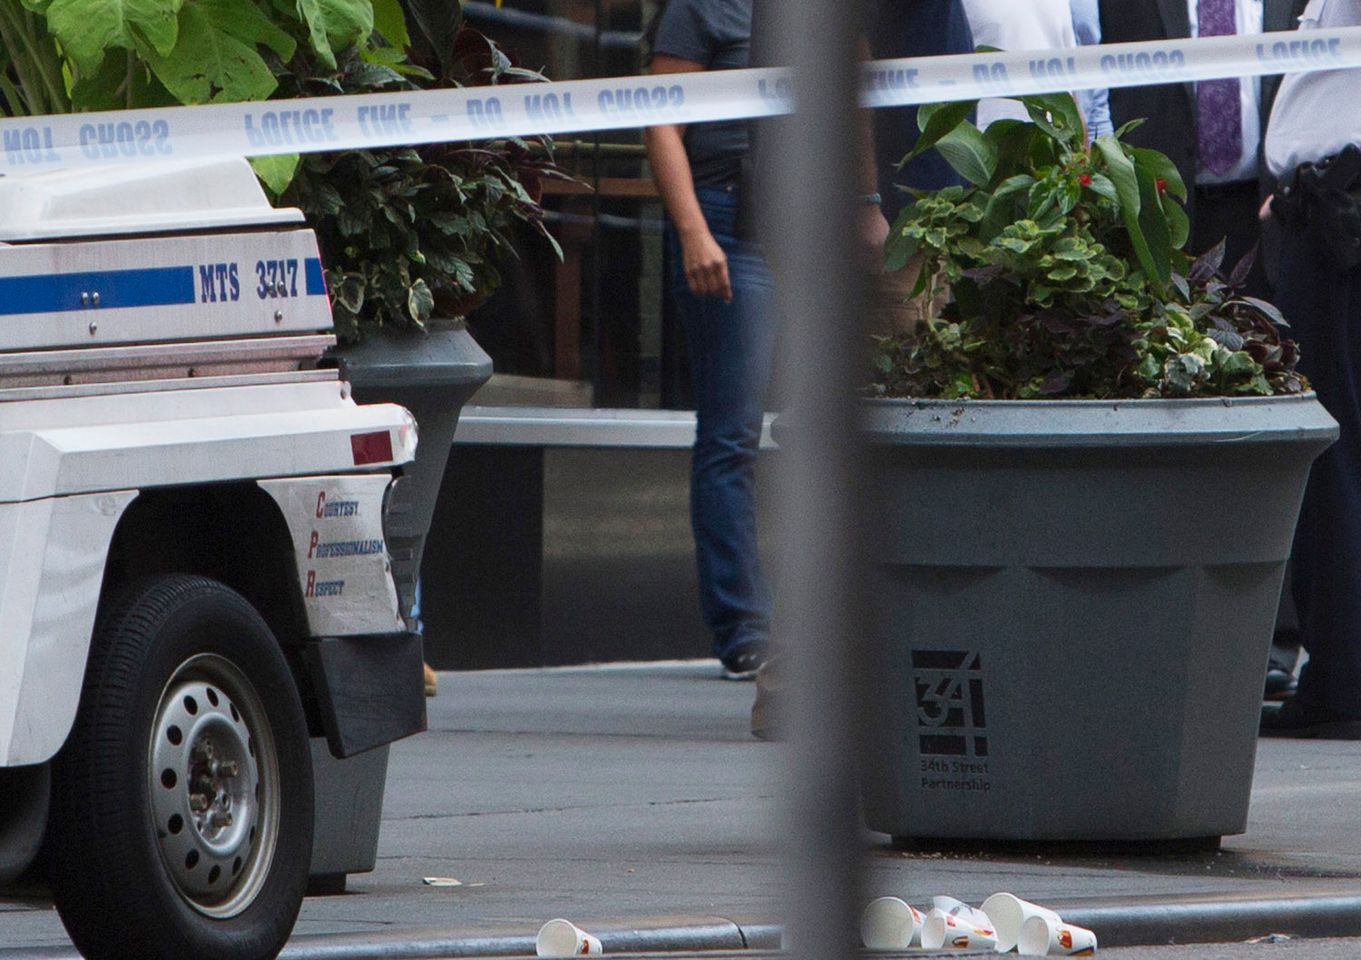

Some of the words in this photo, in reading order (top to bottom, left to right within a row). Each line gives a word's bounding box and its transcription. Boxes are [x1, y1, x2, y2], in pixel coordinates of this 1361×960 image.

[199, 262, 240, 303] MTS
[920, 759, 948, 774] 34th
[952, 759, 990, 775] Street
[920, 777, 991, 792] Partnership
